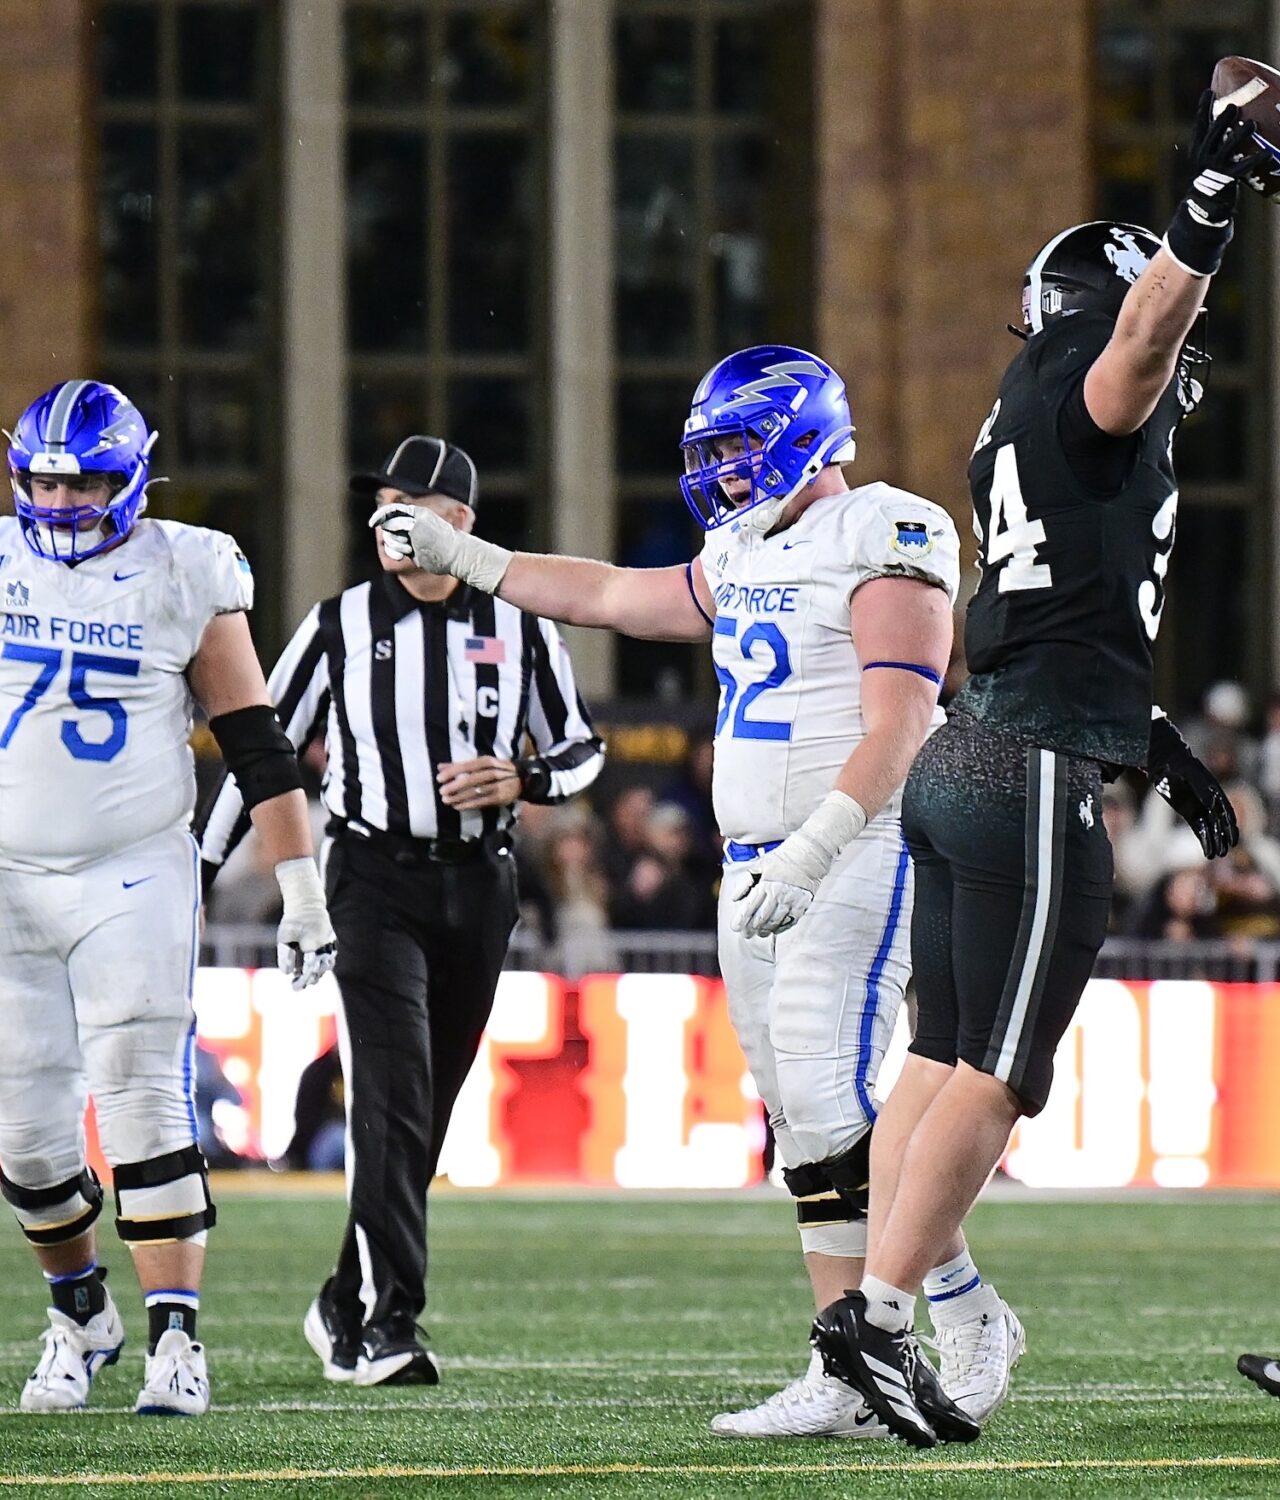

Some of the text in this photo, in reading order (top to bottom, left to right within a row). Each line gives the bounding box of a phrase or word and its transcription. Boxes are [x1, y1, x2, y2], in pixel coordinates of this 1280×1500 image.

[973, 442, 1053, 593] 4
[1, 613, 144, 650] AIR FORCE
[374, 639, 392, 661] S
[713, 615, 793, 742] 52
[1, 641, 141, 763] 75
[476, 685, 499, 718] C
[614, 972, 1217, 1189] LD!
